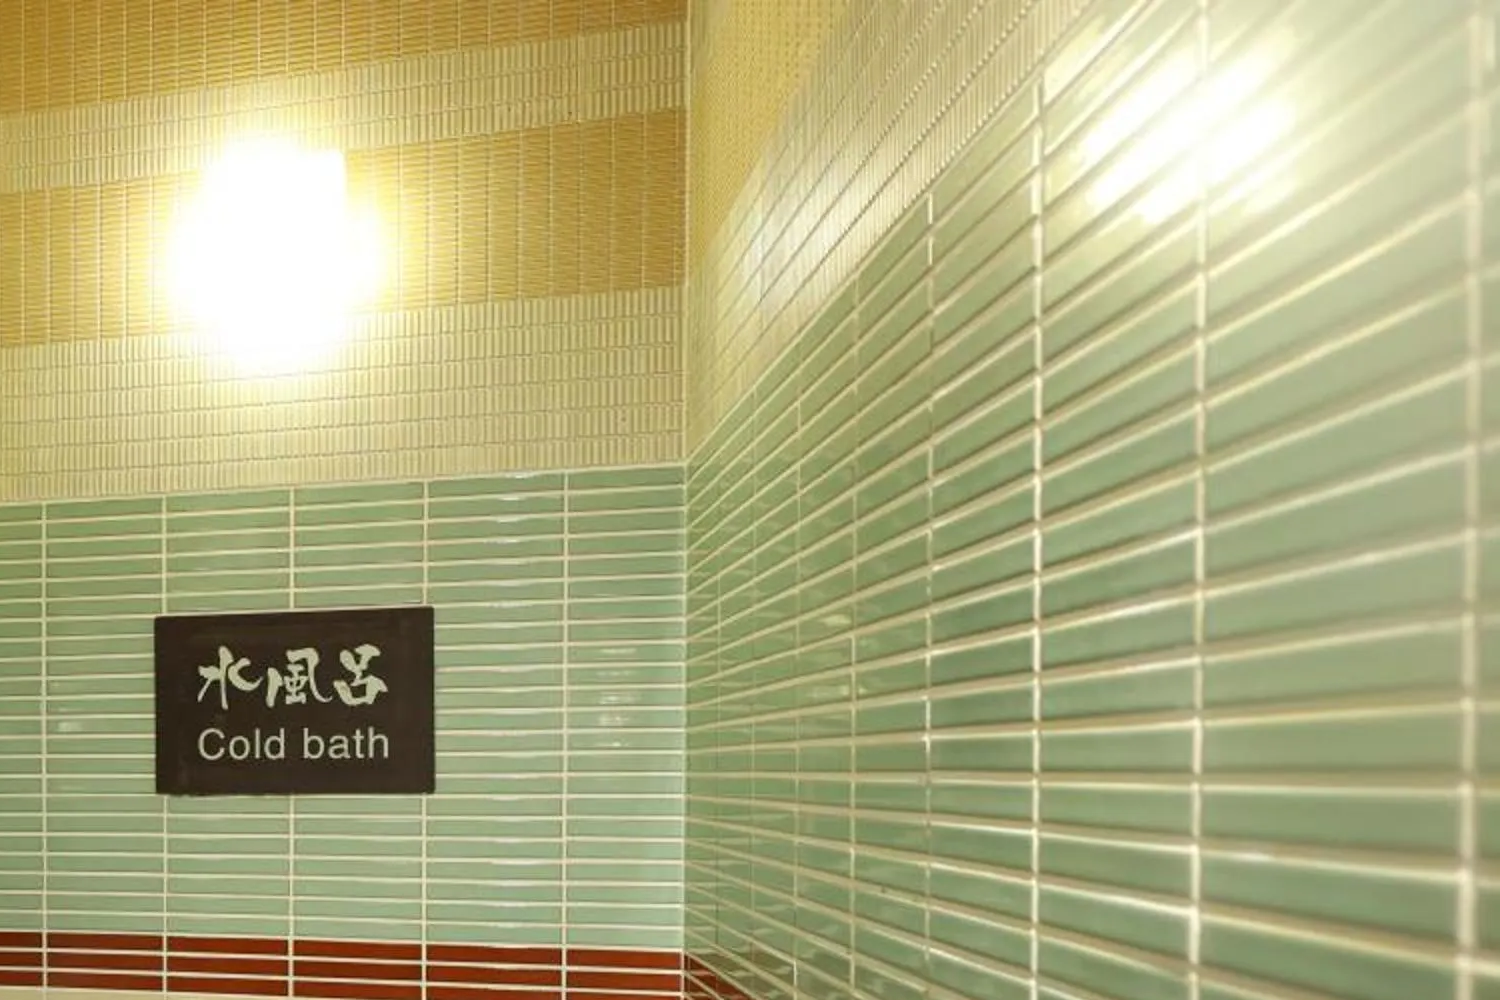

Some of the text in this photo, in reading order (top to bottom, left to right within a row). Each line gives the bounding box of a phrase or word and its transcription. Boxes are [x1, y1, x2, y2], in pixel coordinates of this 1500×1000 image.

[197, 643, 389, 710] 水風呂
[198, 726, 389, 761] Cold bath
